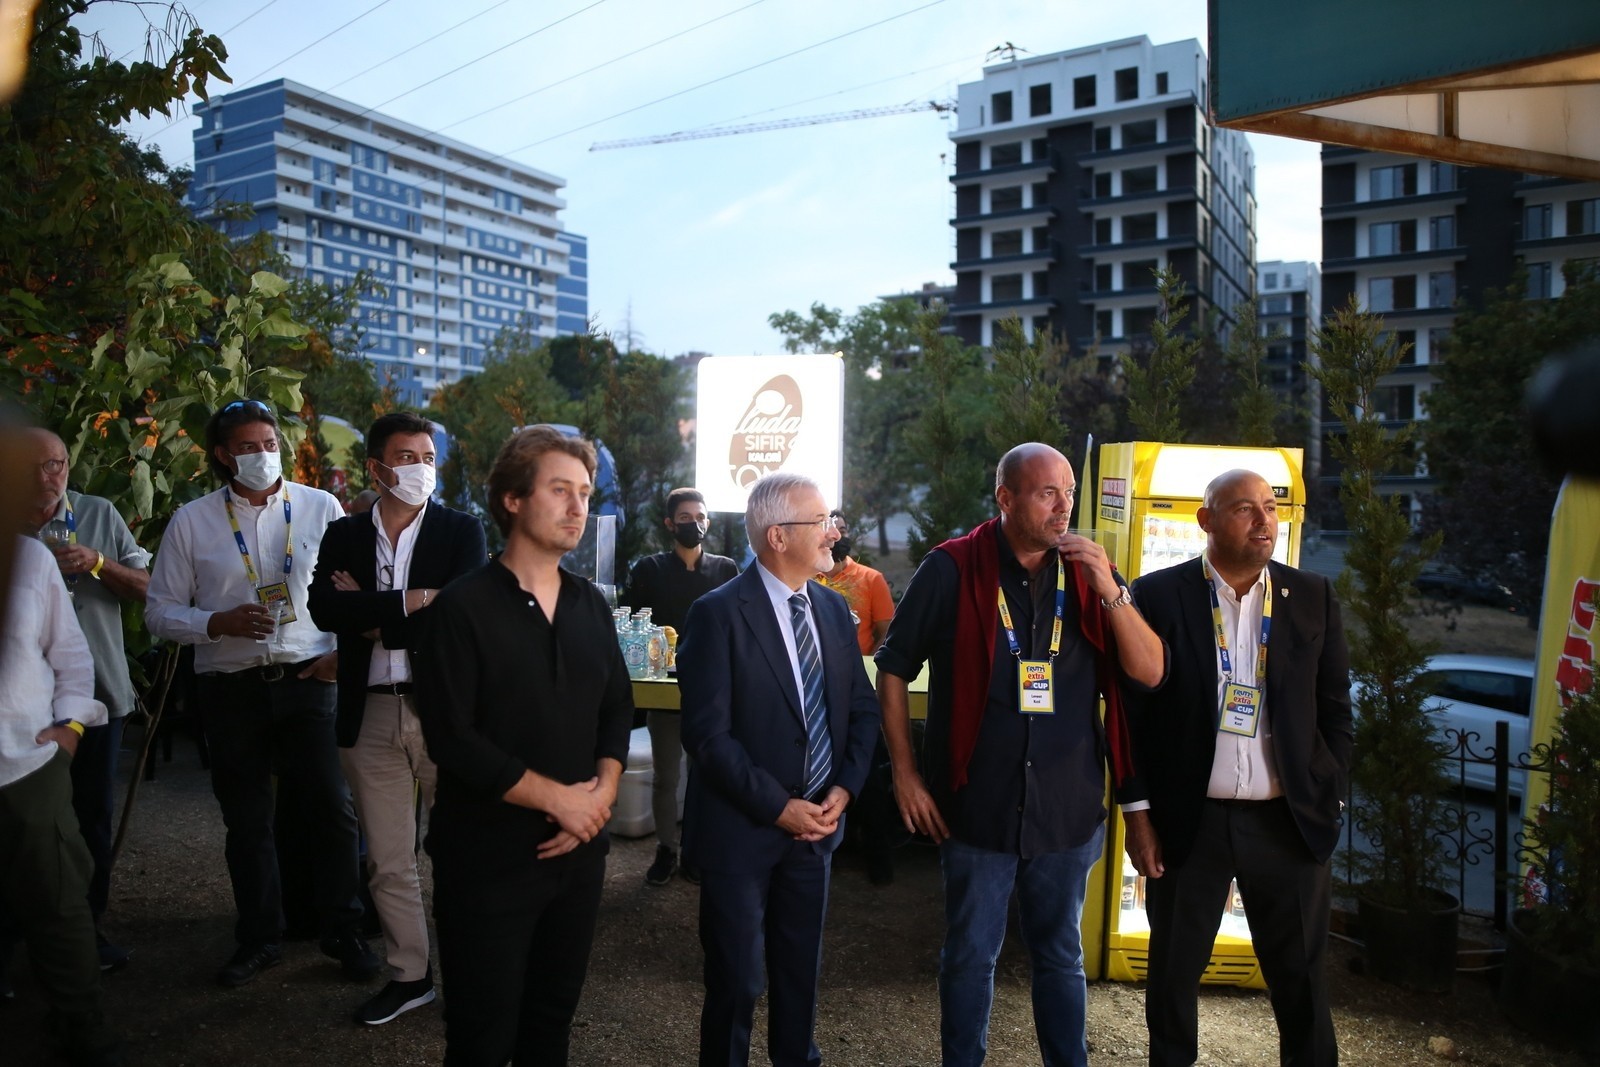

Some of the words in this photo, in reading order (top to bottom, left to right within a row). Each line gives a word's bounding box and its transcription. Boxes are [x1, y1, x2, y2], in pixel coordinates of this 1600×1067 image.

[744, 434, 786, 451] SIFIR
[1233, 696, 1252, 705] extra
[1237, 705, 1254, 714] CUP
